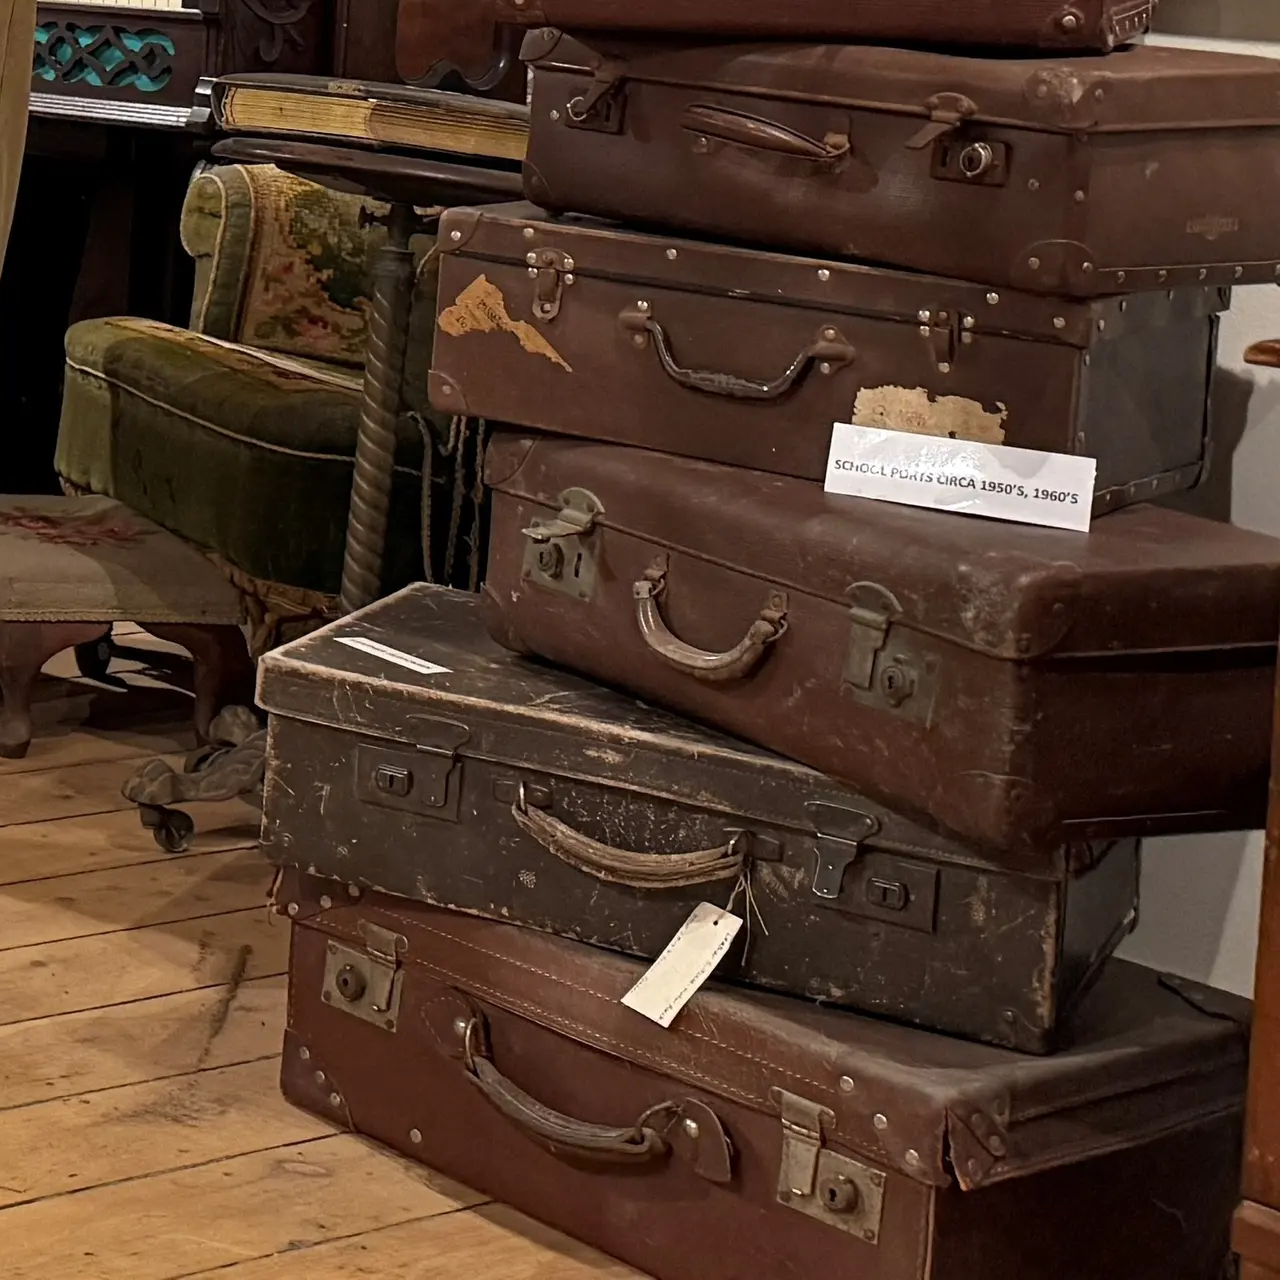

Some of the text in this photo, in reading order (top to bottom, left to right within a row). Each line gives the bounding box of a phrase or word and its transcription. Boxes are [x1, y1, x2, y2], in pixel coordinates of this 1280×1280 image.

[834, 459, 887, 476] SCHOOL
[936, 473, 976, 489] CIRCA
[980, 480, 1028, 499] 1950'S,
[1033, 488, 1079, 504] 1960'S
